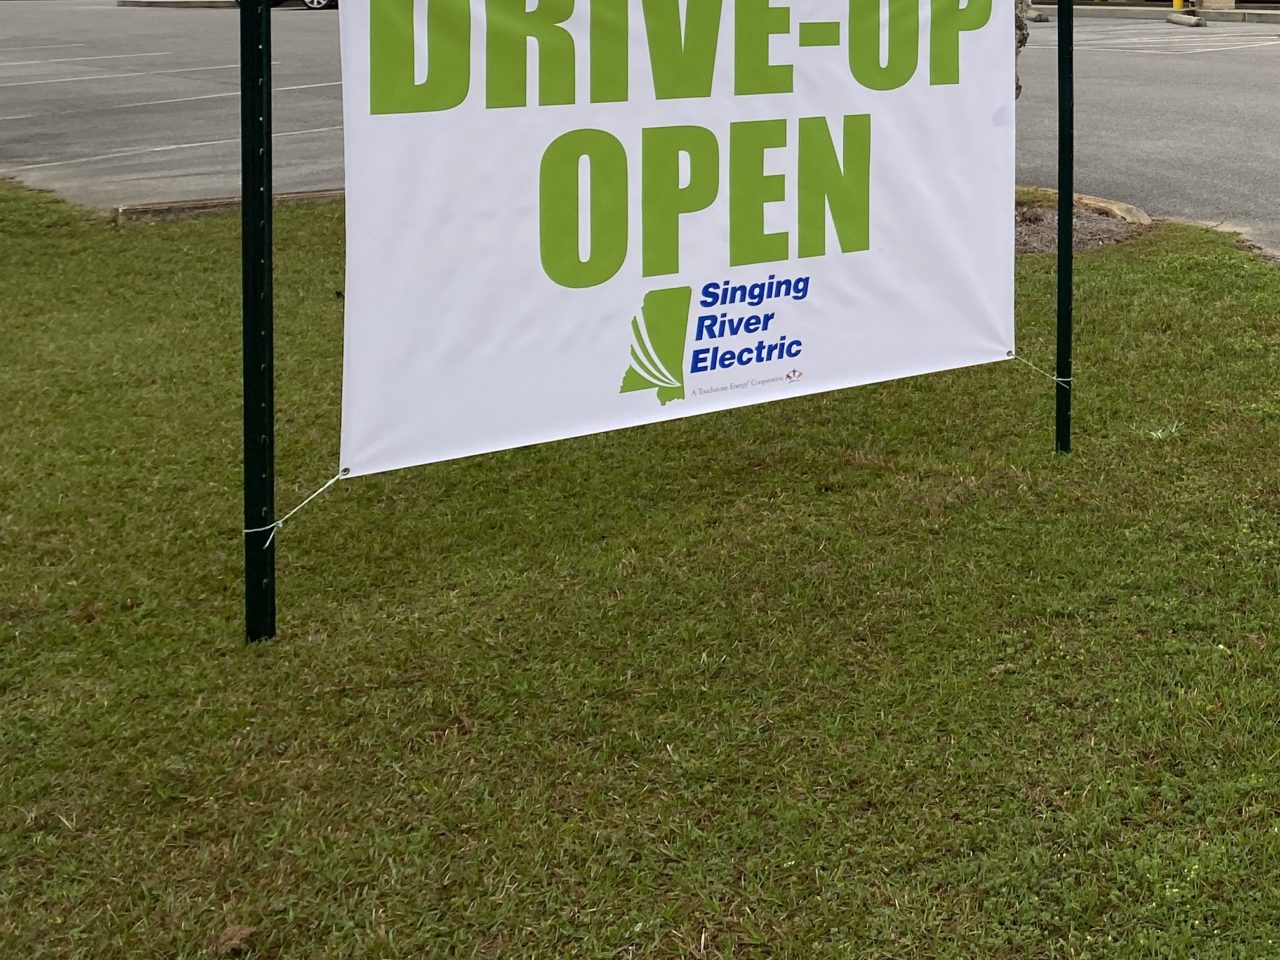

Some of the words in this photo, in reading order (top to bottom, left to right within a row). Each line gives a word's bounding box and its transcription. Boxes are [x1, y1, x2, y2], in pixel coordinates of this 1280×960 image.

[538, 113, 872, 290] OPEN
[699, 273, 811, 309] Singing
[694, 311, 776, 342] River
[689, 335, 803, 375] Electric
